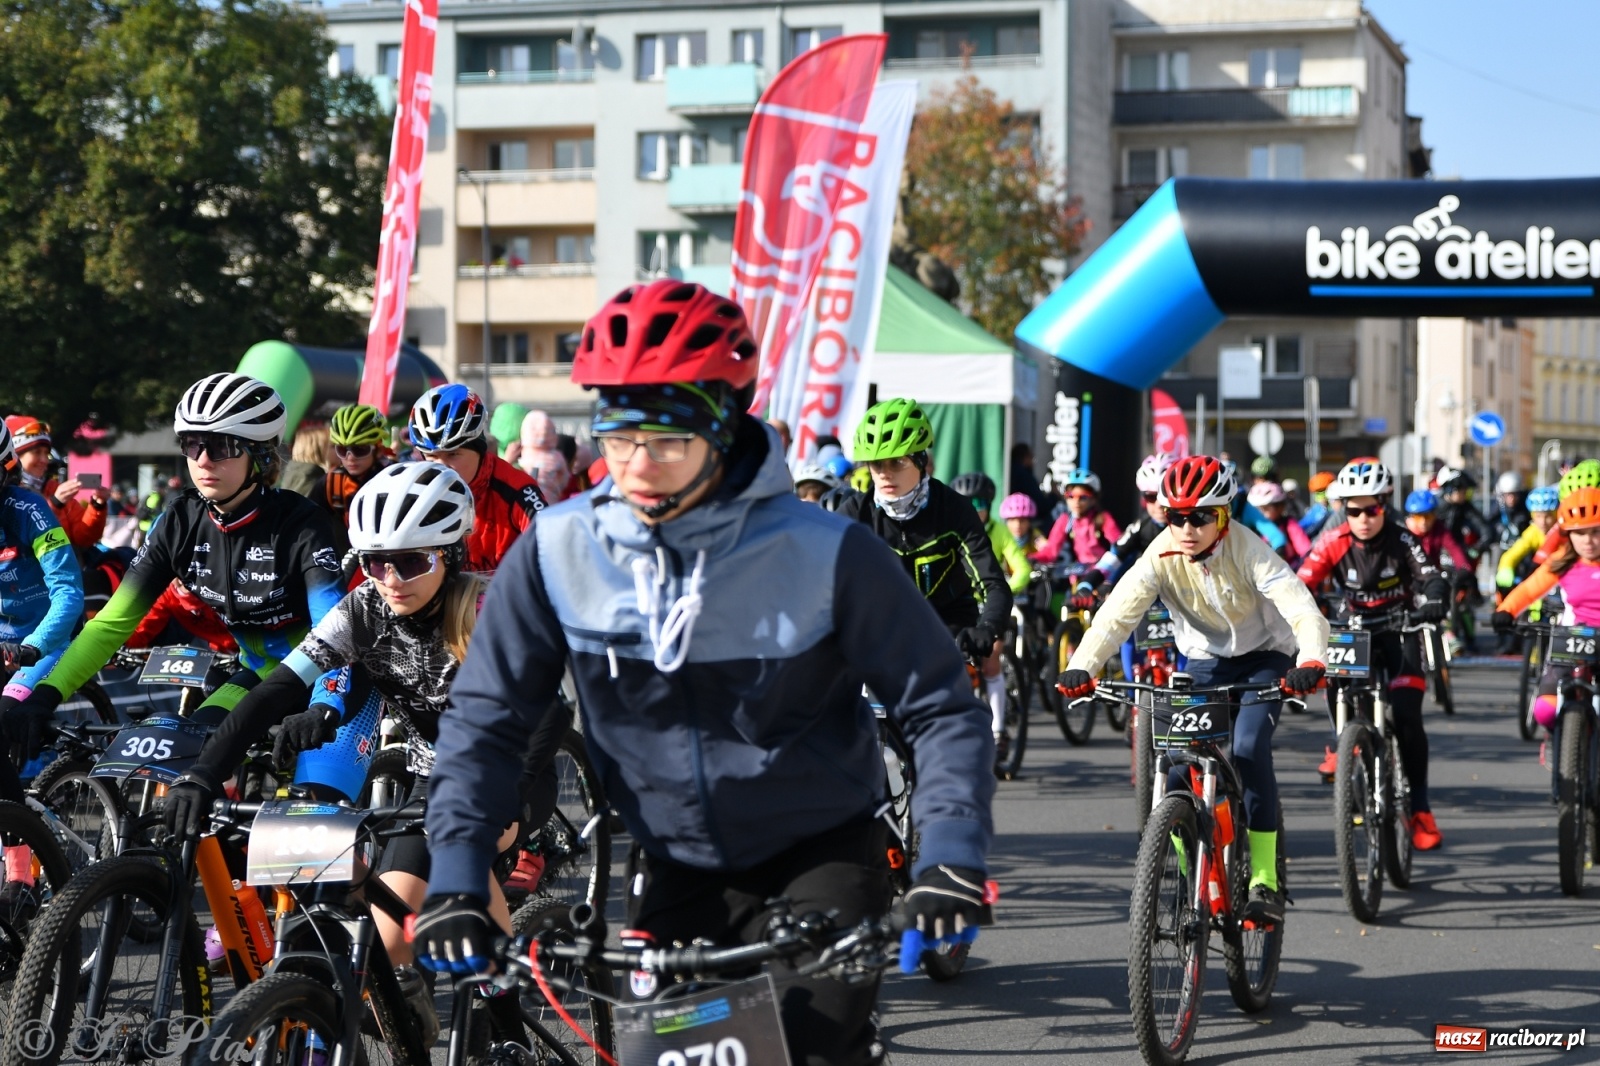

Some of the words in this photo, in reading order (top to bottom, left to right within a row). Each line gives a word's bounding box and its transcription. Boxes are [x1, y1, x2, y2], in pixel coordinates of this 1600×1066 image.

[1306, 226, 1421, 280] bike
[799, 134, 877, 461] RACIBÓRZ
[237, 594, 263, 604] BILANS
[159, 659, 194, 675] 168
[1326, 648, 1356, 665] 274
[1171, 712, 1212, 733] 226
[120, 736, 175, 760] 305
